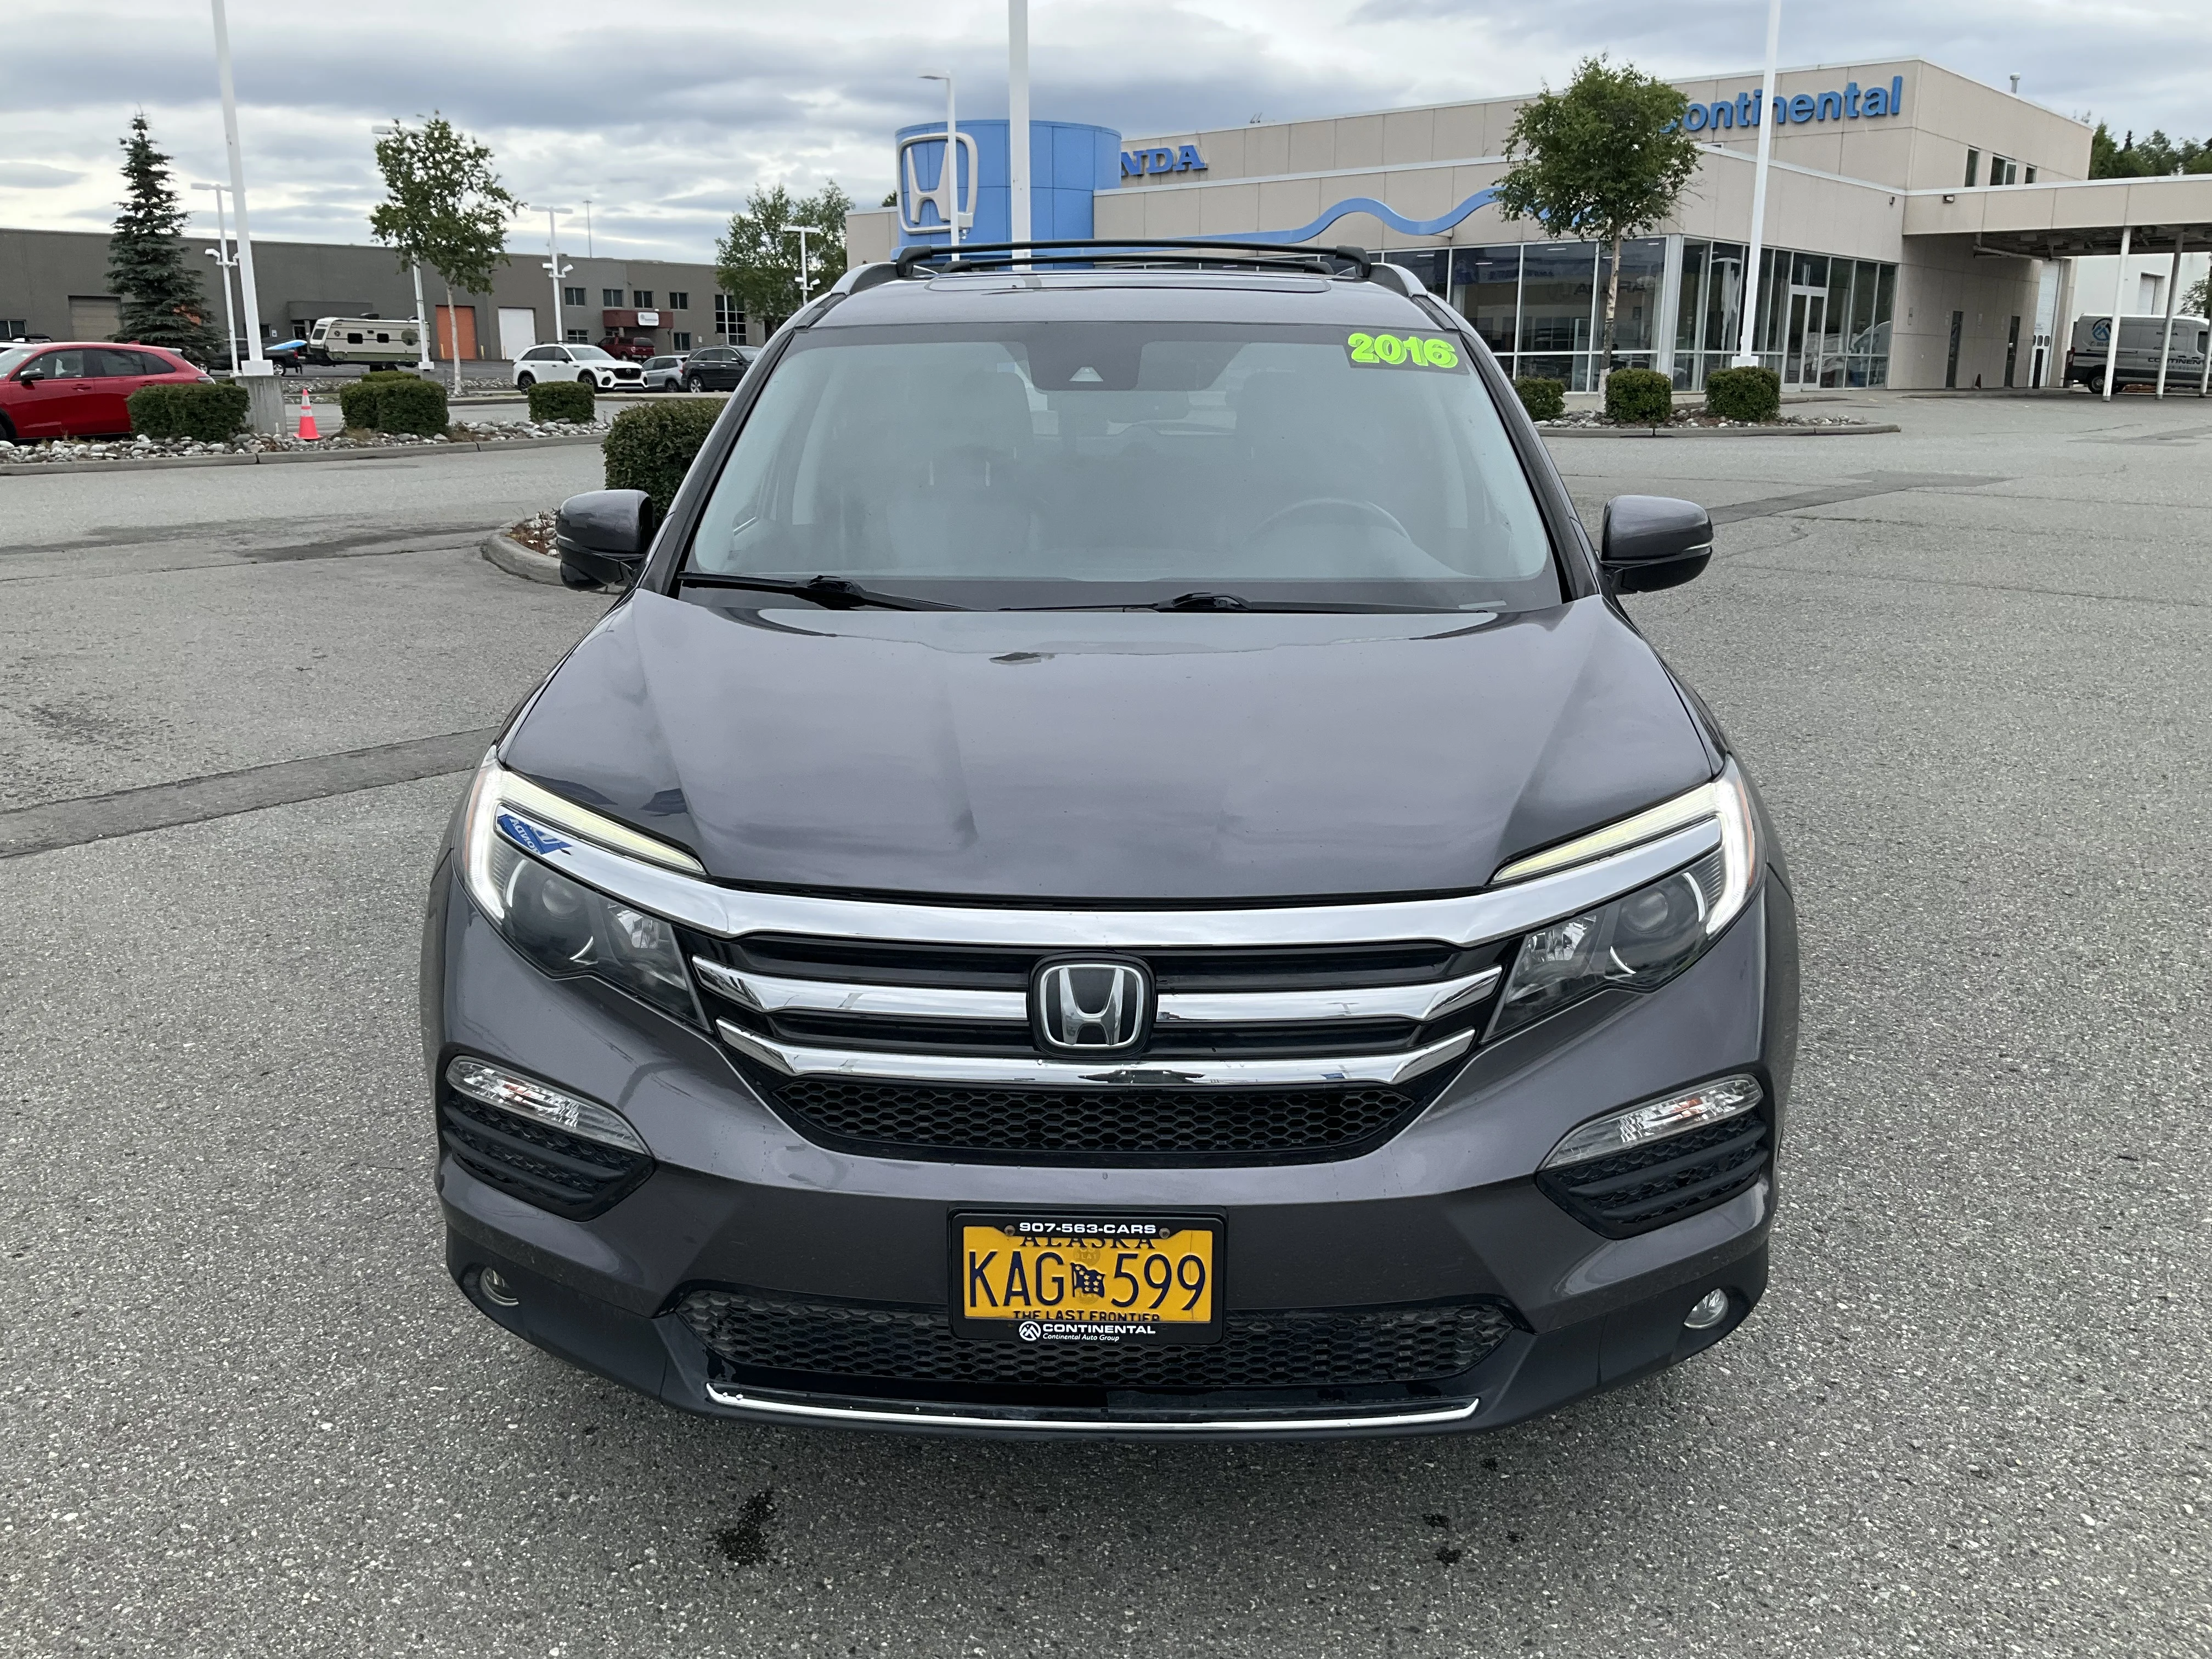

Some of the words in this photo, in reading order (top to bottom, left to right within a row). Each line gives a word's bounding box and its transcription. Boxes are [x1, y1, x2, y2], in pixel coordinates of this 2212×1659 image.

[1348, 332, 1458, 368] 2016
[1019, 1222, 1156, 1234] 907-563-CARS
[969, 1251, 1064, 1307] KAG
[1111, 1253, 1206, 1310] 599
[1013, 1310, 1041, 1319] THE
[1046, 1310, 1085, 1321] LAST
[1042, 1323, 1156, 1334] CONTINENTAL
